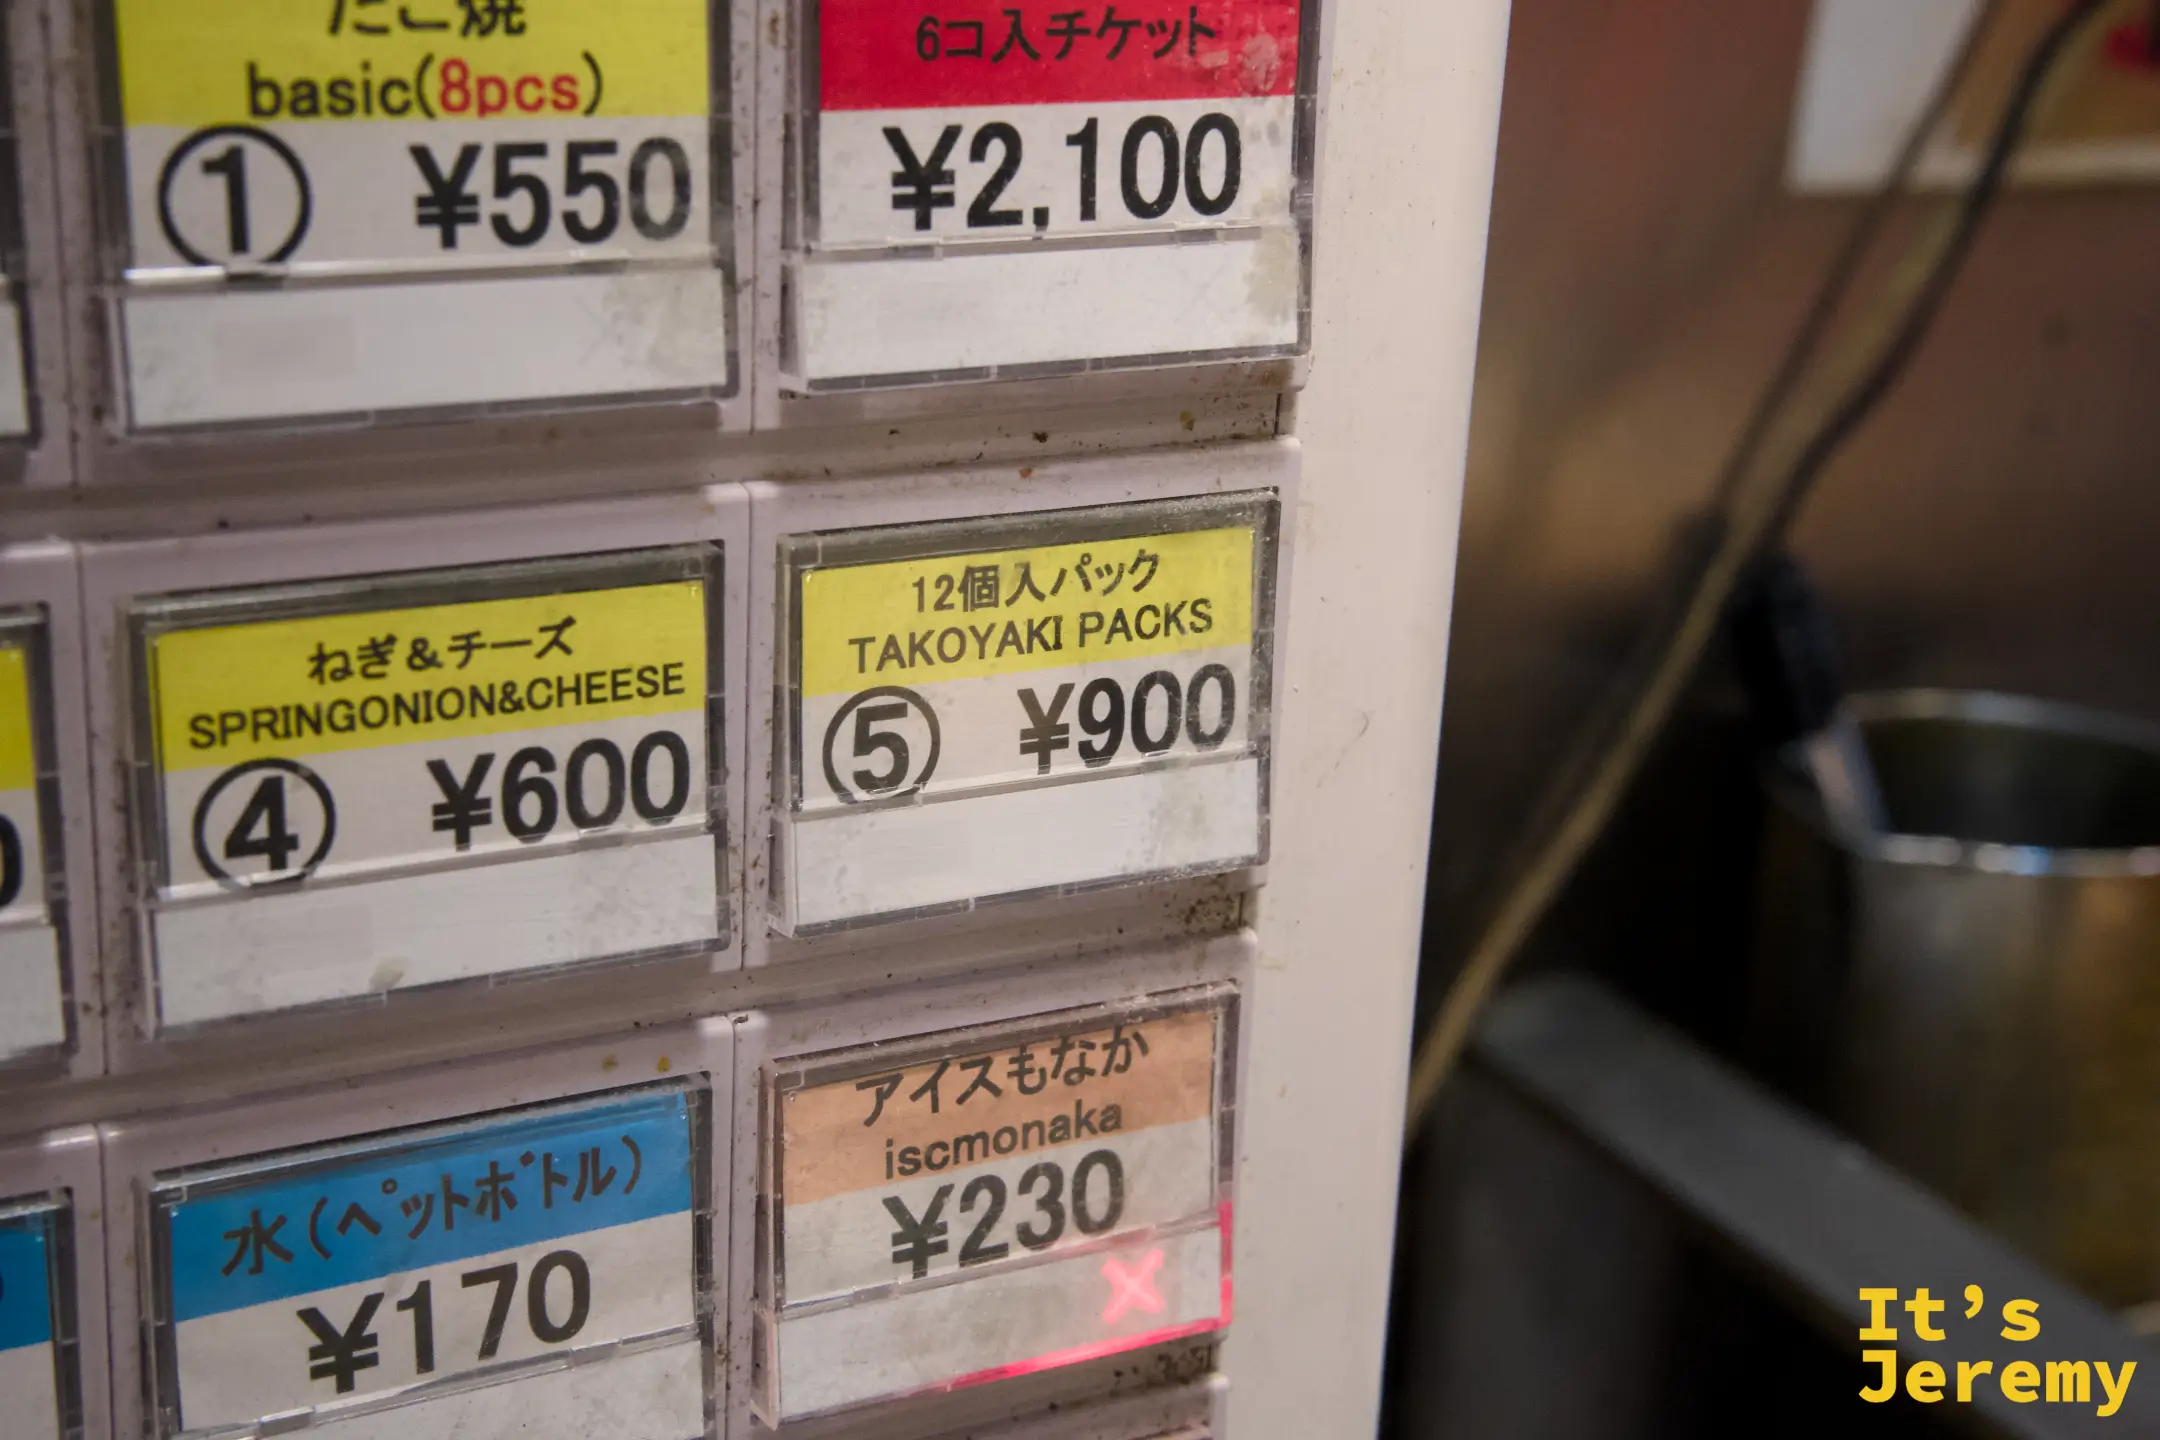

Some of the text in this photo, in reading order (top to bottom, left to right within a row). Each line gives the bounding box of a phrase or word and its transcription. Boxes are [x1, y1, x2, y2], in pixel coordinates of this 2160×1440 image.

[246, 51, 604, 119] basic(8pcs)
[915, 5, 1216, 64] 6コ入チケット
[408, 136, 692, 249] ¥550
[882, 111, 1242, 238] ¥2,100
[912, 548, 1160, 613] 12個入パック
[849, 598, 1214, 673] TAKOYAKI PACKS
[188, 661, 686, 749] SPRINGONION&CHEESE
[1017, 663, 1236, 775] ¥900
[426, 730, 691, 852] ¥600
[855, 1026, 1150, 1127] アイスもなか
[885, 1099, 1123, 1179] iscmonaka
[882, 1148, 1125, 1279] ¥230
[296, 1249, 591, 1394] ¥170
